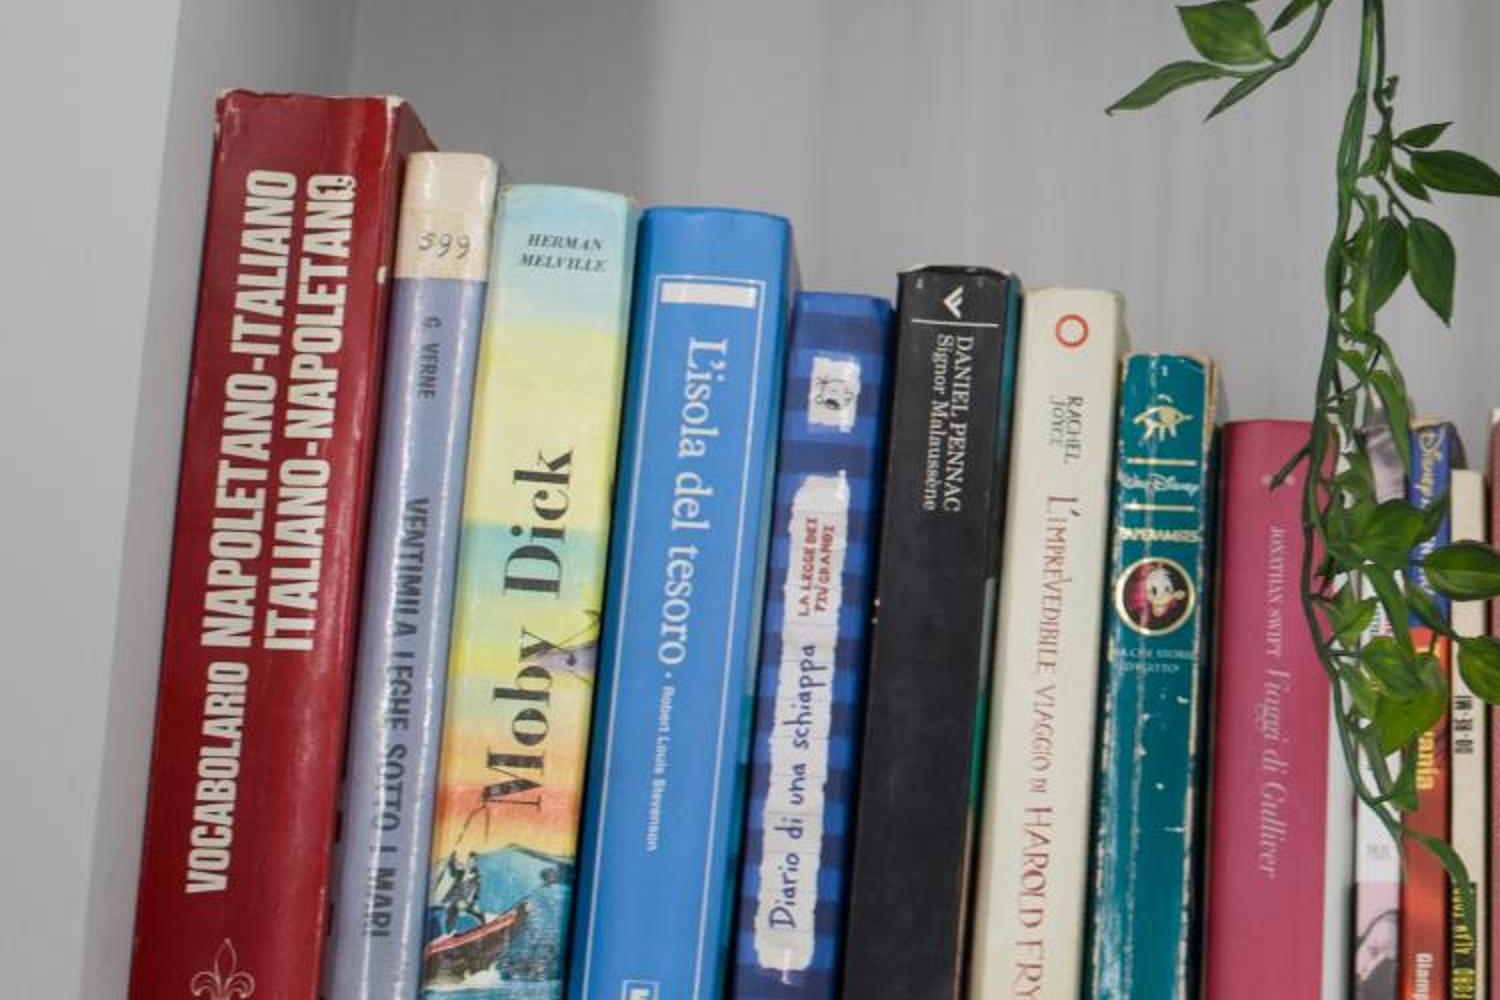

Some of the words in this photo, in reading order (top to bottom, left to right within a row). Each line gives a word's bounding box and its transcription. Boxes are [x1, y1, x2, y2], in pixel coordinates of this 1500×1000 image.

[518, 254, 608, 272] MELVILLE
[527, 233, 603, 251] HERMAN
[417, 343, 441, 400] VERNE
[677, 335, 730, 460] L'isola
[930, 333, 954, 396] Signor
[949, 335, 975, 418] DANIEL
[1049, 396, 1067, 447] JOYCE
[1064, 395, 1085, 464] RACHEL
[942, 422, 969, 513] PENNAC
[1415, 428, 1443, 497] Disney
[503, 449, 574, 599] Dick
[671, 471, 715, 532] del
[804, 517, 818, 545] DEI
[395, 497, 431, 637] VENTIMILA
[799, 547, 816, 590] LEGGE
[817, 524, 835, 584] GRANDI
[1264, 524, 1286, 605] JONATHAN
[657, 545, 700, 666] tesoro
[797, 595, 811, 617] LA
[384, 651, 418, 731] LEGHE
[482, 625, 566, 812] Moby
[657, 686, 675, 732] Robert
[782, 644, 828, 749] schiappa
[1254, 668, 1292, 745] Viaggi
[653, 737, 672, 775] Louis
[1028, 684, 1057, 774] VIAGGIO
[1262, 750, 1289, 774] di
[186, 661, 249, 894] VOCABOLARIO
[375, 744, 407, 831] SOTTO
[788, 762, 807, 806] una
[645, 779, 668, 852] Stevenson
[773, 816, 804, 841] di
[1259, 781, 1289, 880] Gulliver
[769, 852, 800, 929] Diario
[1018, 805, 1054, 929] HAROLD
[362, 868, 397, 938] MARI
[1011, 940, 1045, 1000] FRY
